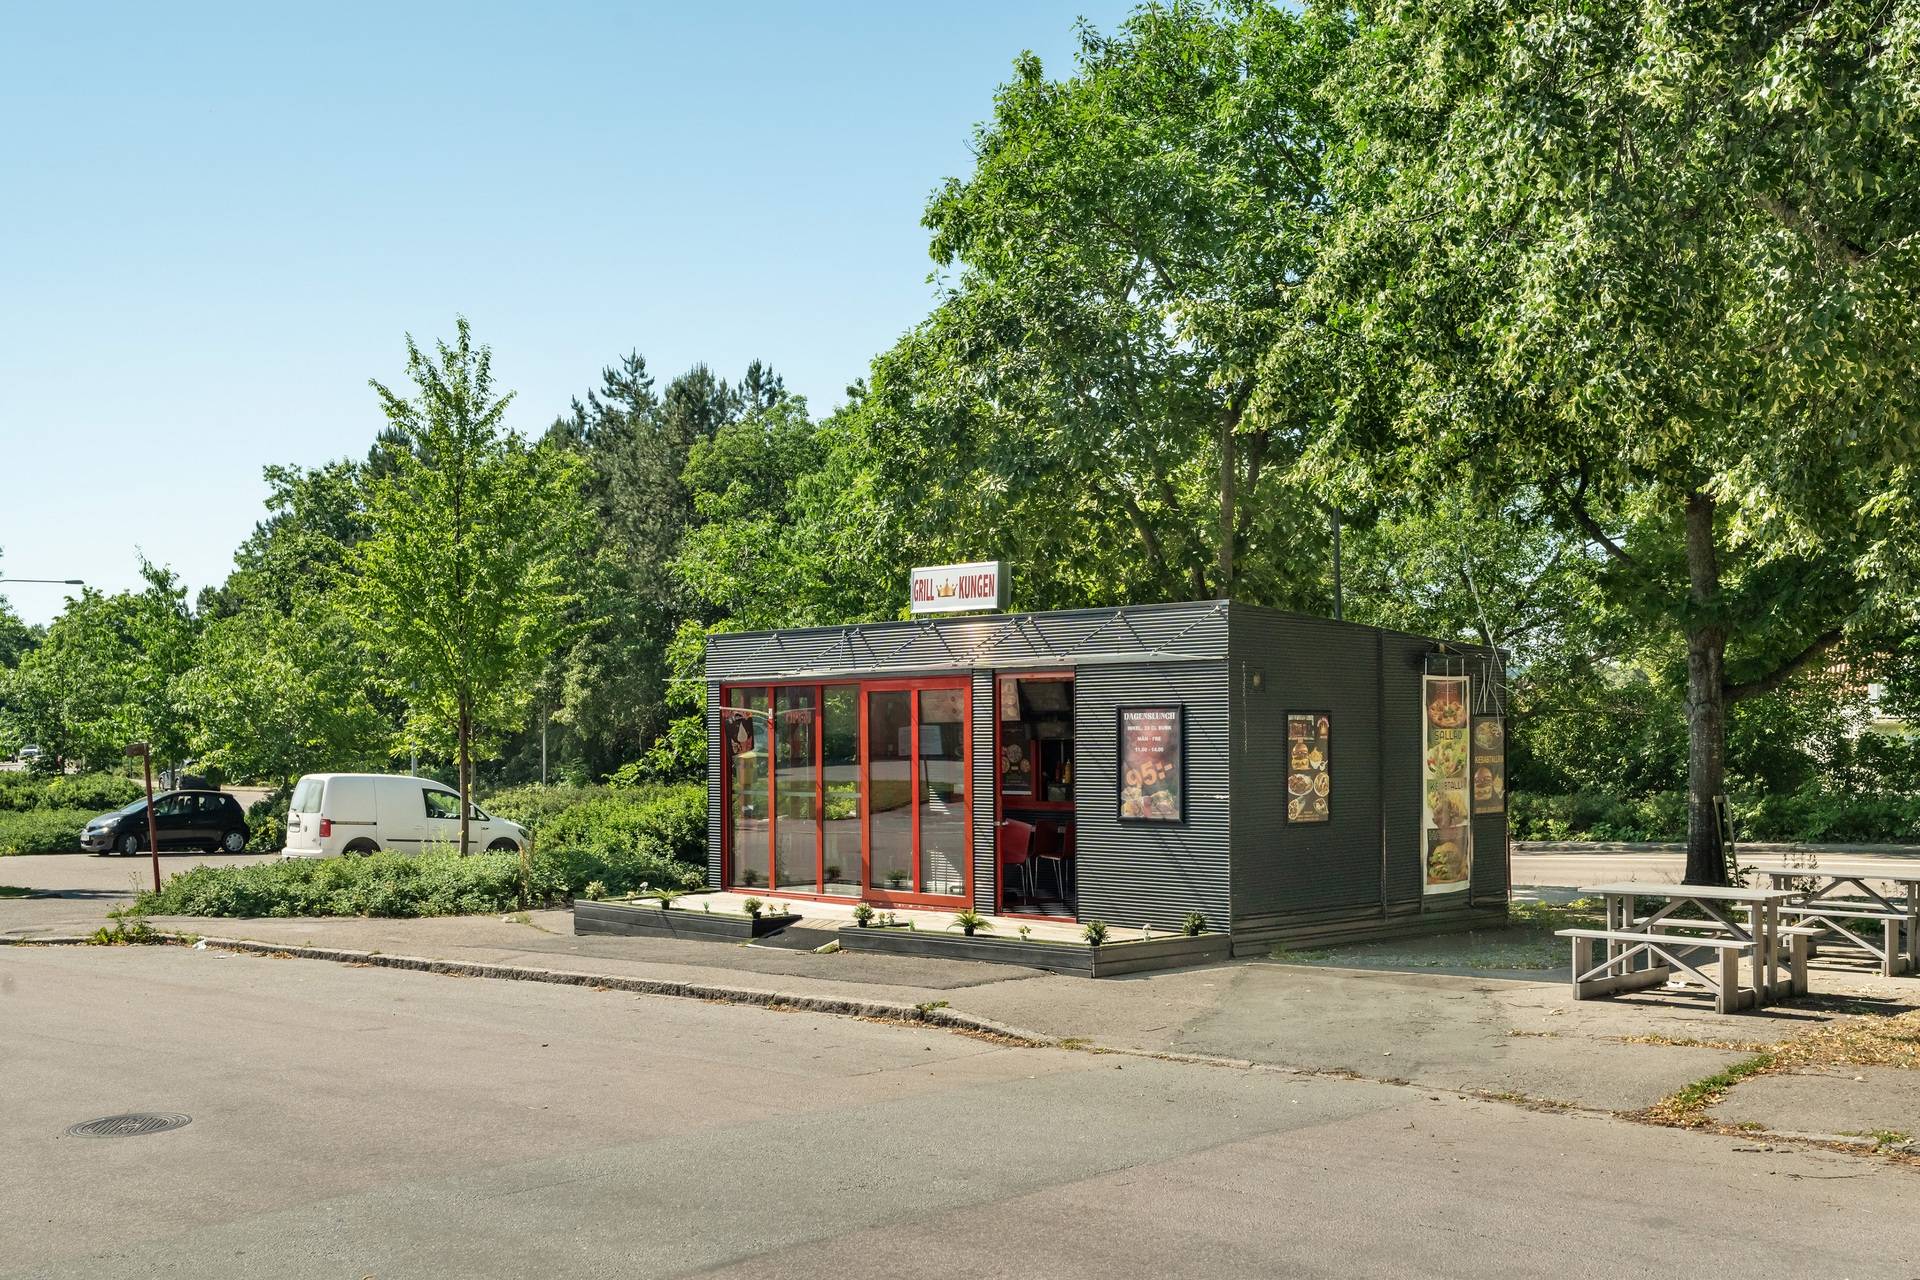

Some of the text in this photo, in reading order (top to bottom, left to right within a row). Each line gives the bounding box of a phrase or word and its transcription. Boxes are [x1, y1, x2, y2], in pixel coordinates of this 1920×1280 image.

[914, 574, 995, 601] GRILL KUNGEN
[1124, 712, 1175, 720] DAGENSLUNCH
[1434, 730, 1463, 741] SALLAD
